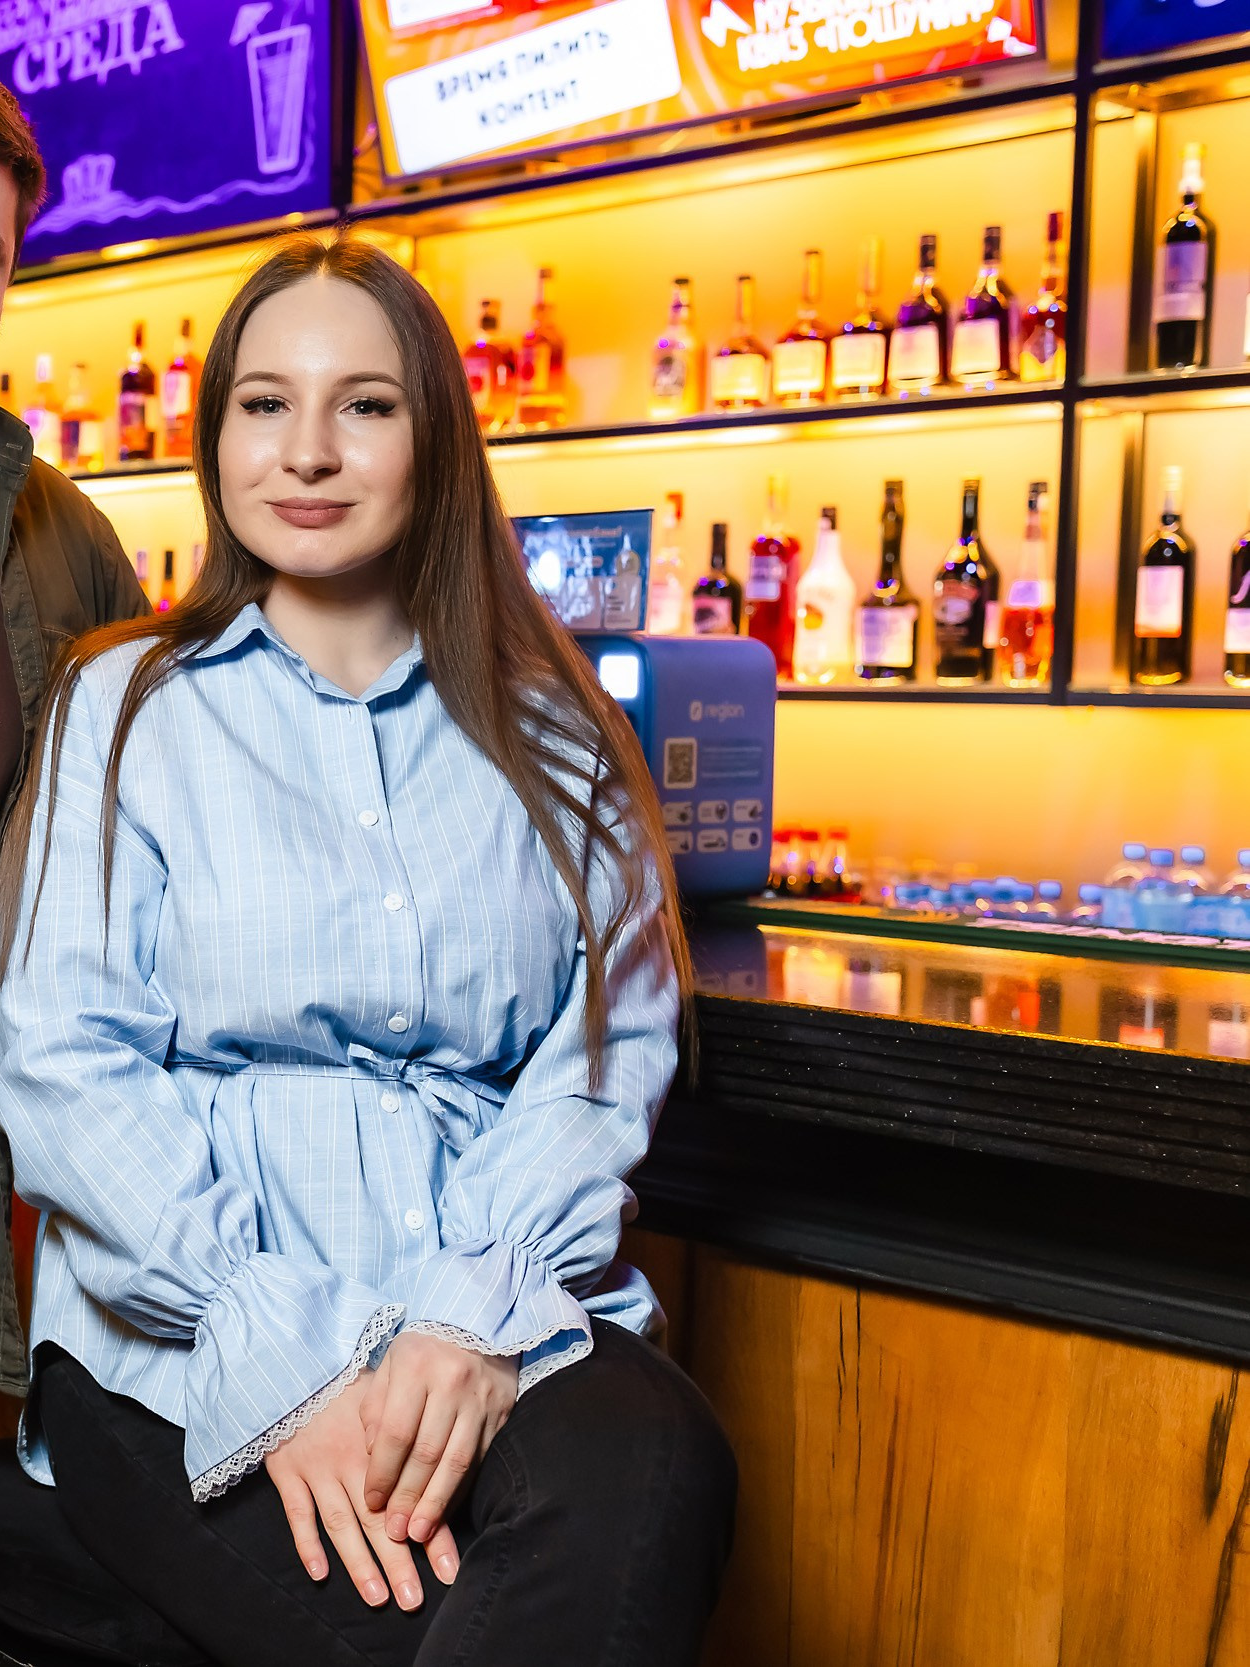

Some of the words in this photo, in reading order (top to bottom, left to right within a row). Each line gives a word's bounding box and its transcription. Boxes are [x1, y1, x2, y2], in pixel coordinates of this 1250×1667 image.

[12, 1, 185, 94] СРЕДА
[435, 60, 508, 102] ВРЕМЯ
[515, 29, 613, 76] ПИЛИТЬ
[477, 79, 581, 127] КОНТЕНТ
